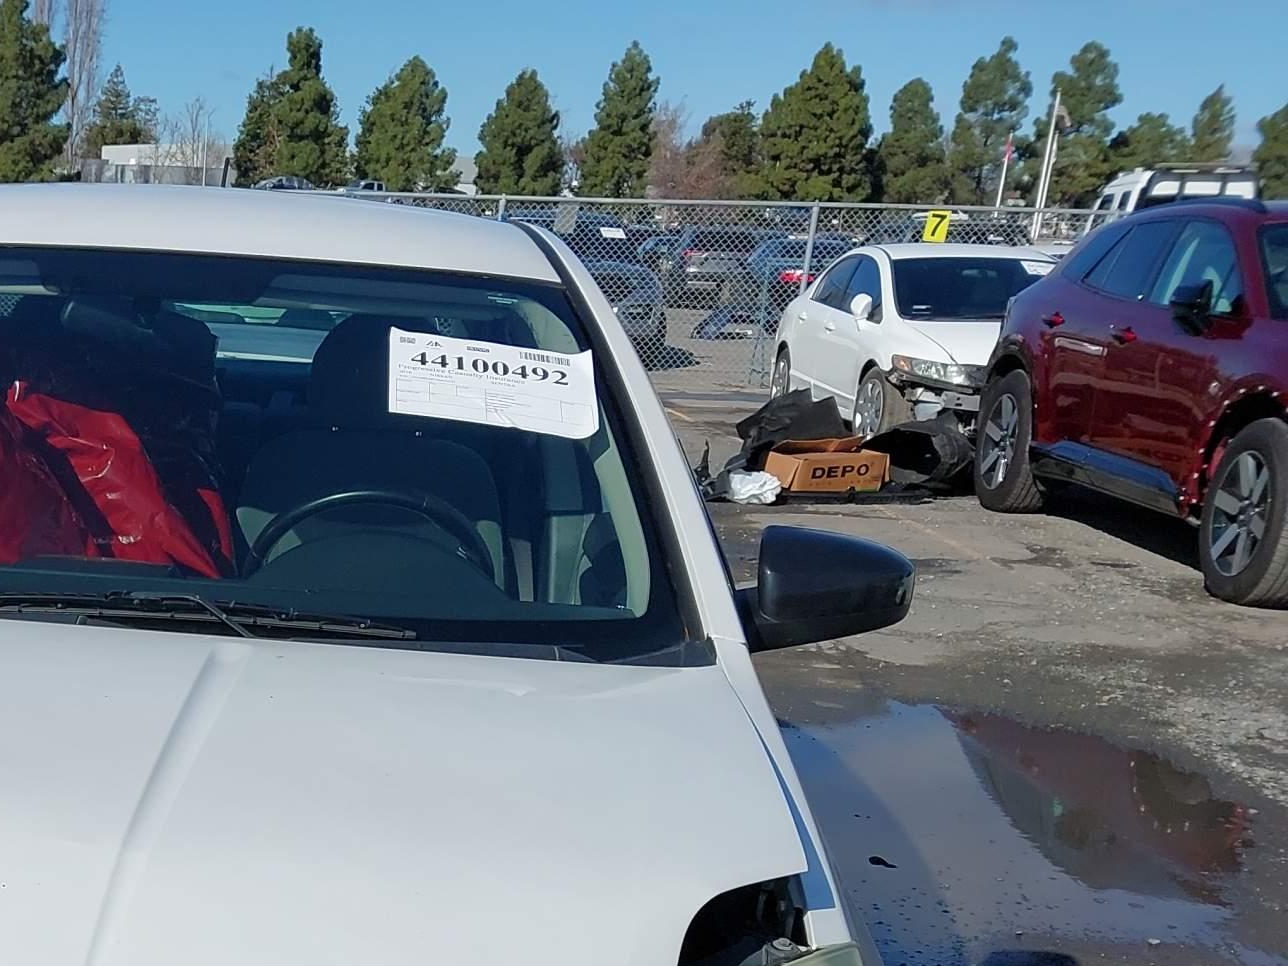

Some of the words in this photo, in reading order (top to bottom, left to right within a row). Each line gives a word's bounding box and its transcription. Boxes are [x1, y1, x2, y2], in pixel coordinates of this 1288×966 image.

[930, 213, 948, 237] 7
[398, 363, 446, 374] Progressive
[448, 369, 483, 379] Casualty
[410, 351, 569, 386] 44100492
[811, 463, 870, 480] DEPO
